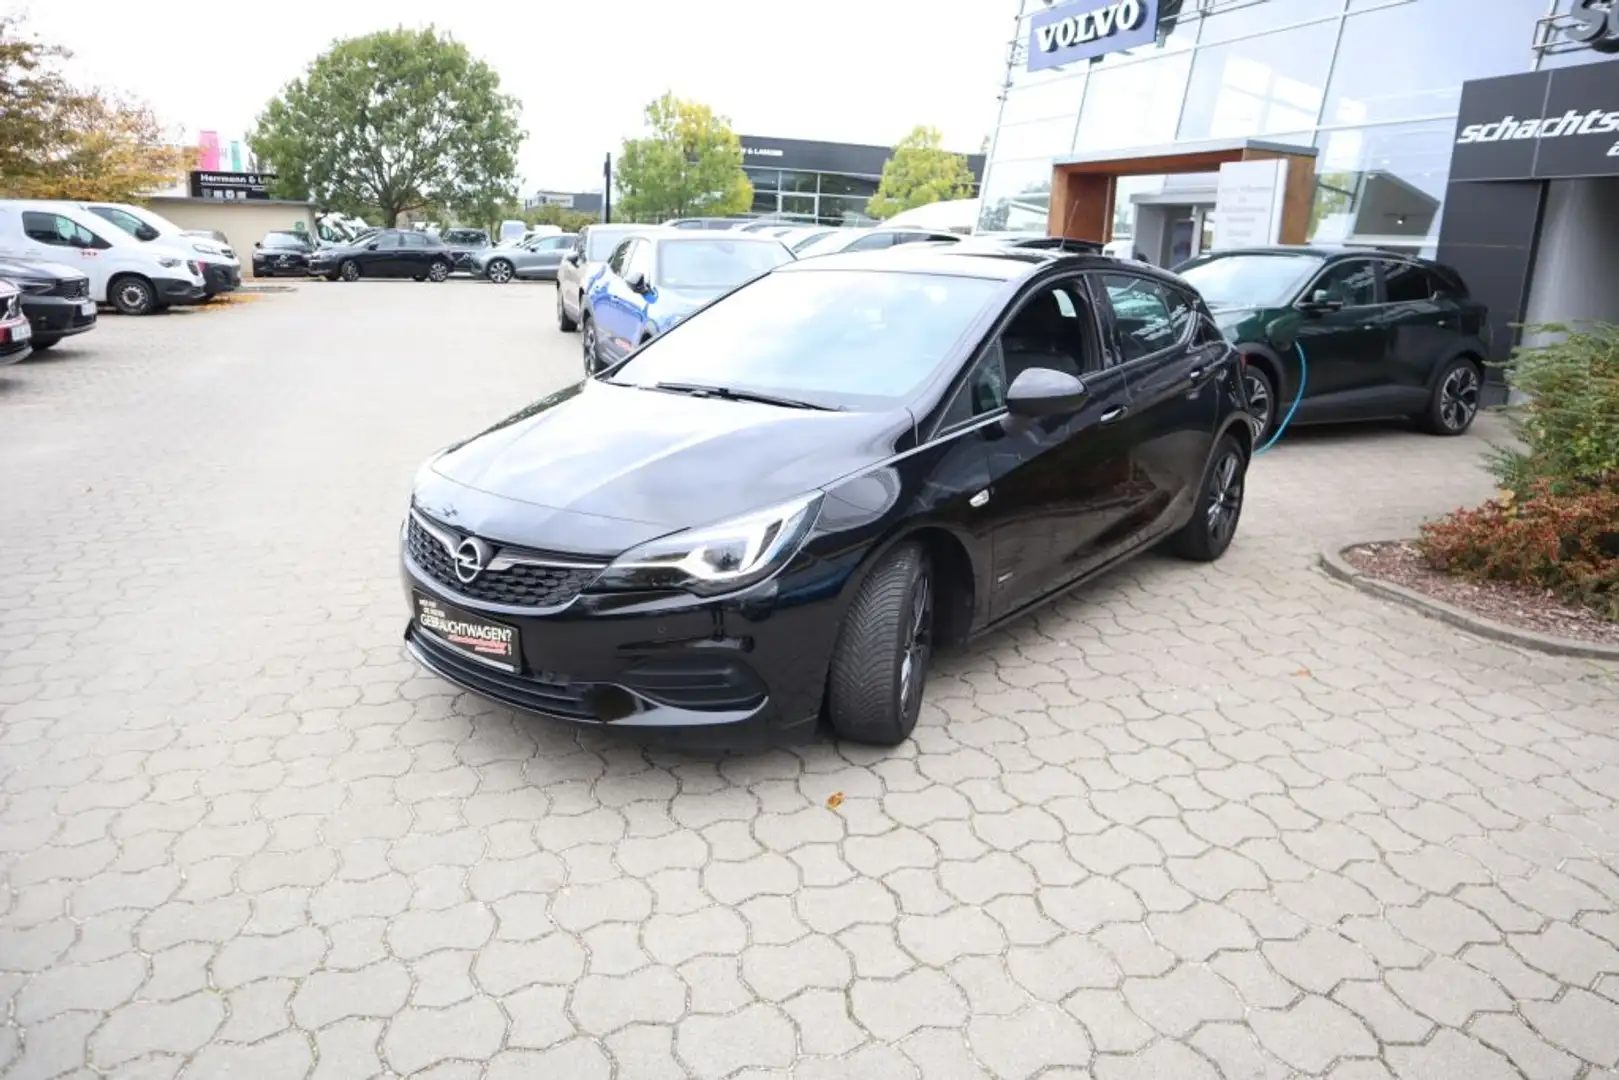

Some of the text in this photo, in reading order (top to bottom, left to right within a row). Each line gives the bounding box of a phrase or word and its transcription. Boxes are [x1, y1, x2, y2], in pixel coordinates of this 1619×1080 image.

[1036, 0, 1143, 52] VOLVO
[1456, 108, 1619, 144] schachts
[420, 613, 512, 642] GEBRAUCHTWAGEN?
